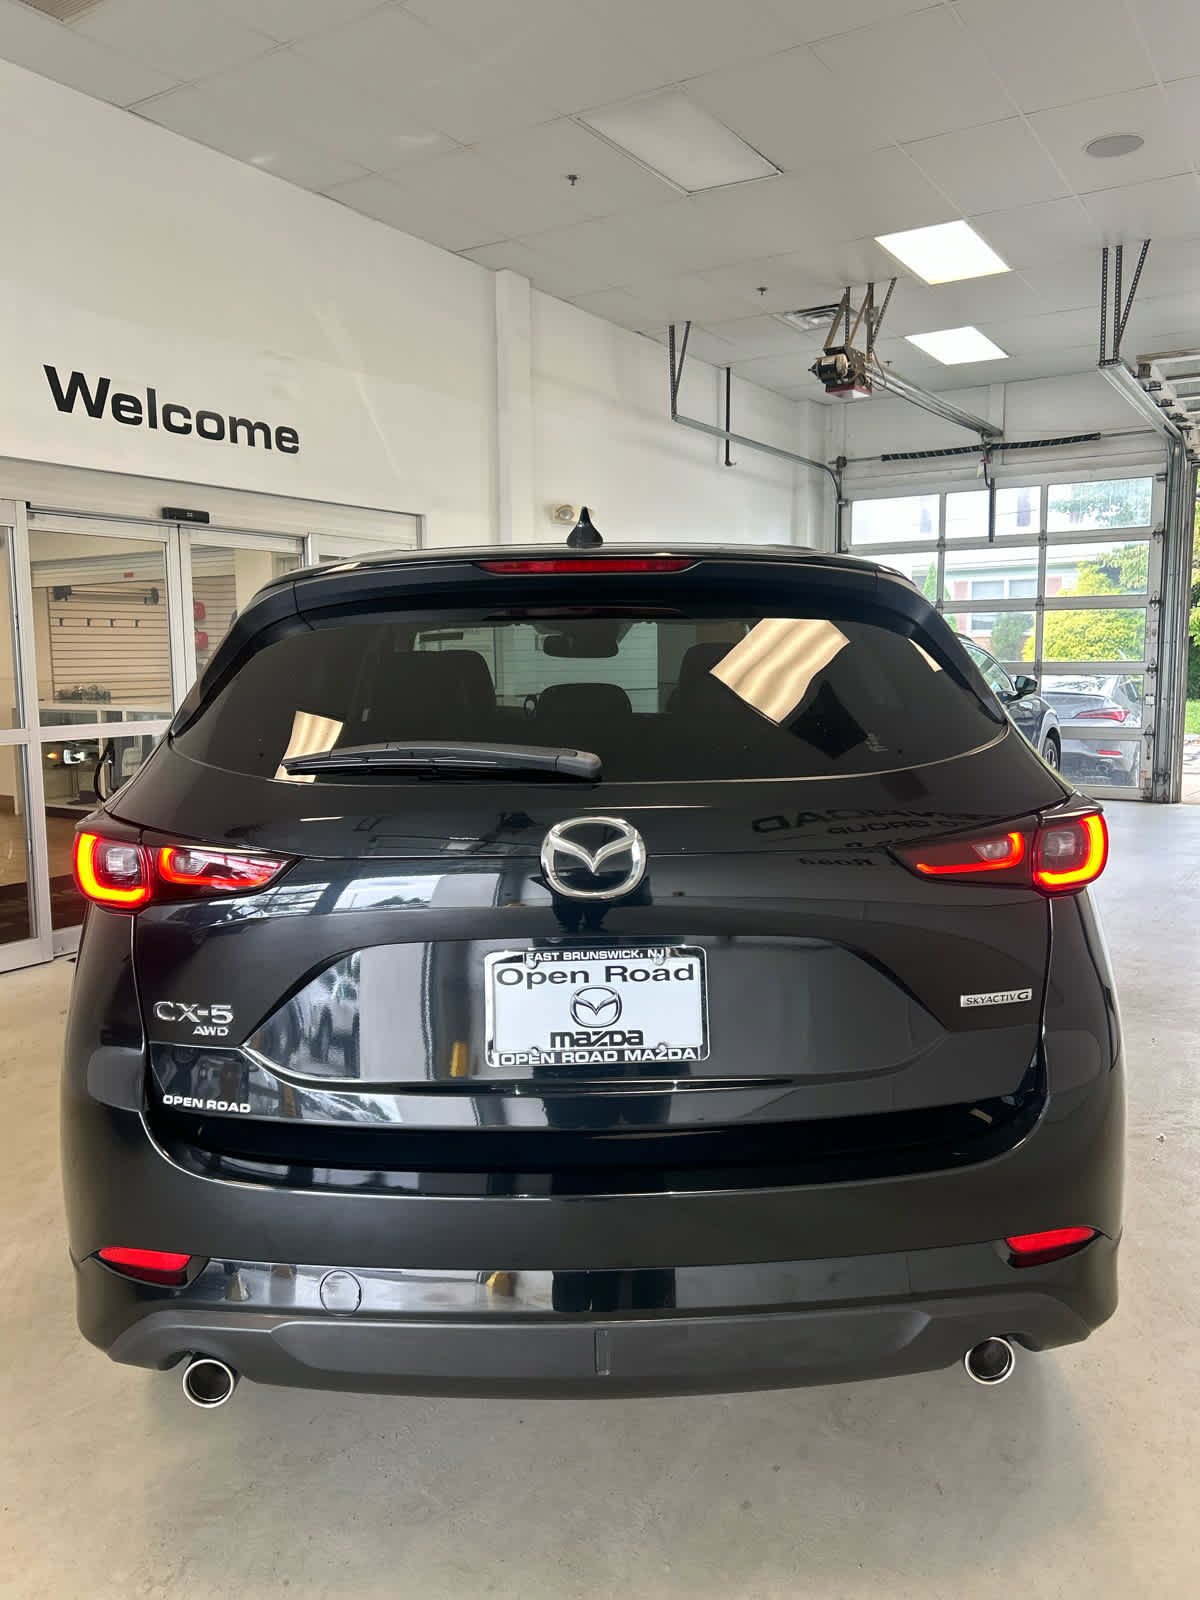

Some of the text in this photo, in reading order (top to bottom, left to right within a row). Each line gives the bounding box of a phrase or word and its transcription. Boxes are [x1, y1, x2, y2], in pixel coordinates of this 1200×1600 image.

[43, 364, 300, 454] Welcome
[647, 948, 665, 958] NJ
[496, 963, 695, 990] Open Road
[153, 1001, 234, 1024] CX-5
[192, 1026, 229, 1036] AWD
[501, 1047, 697, 1065] OPEN ROAD MAZDA
[163, 1094, 252, 1113] OPEN ROAD
